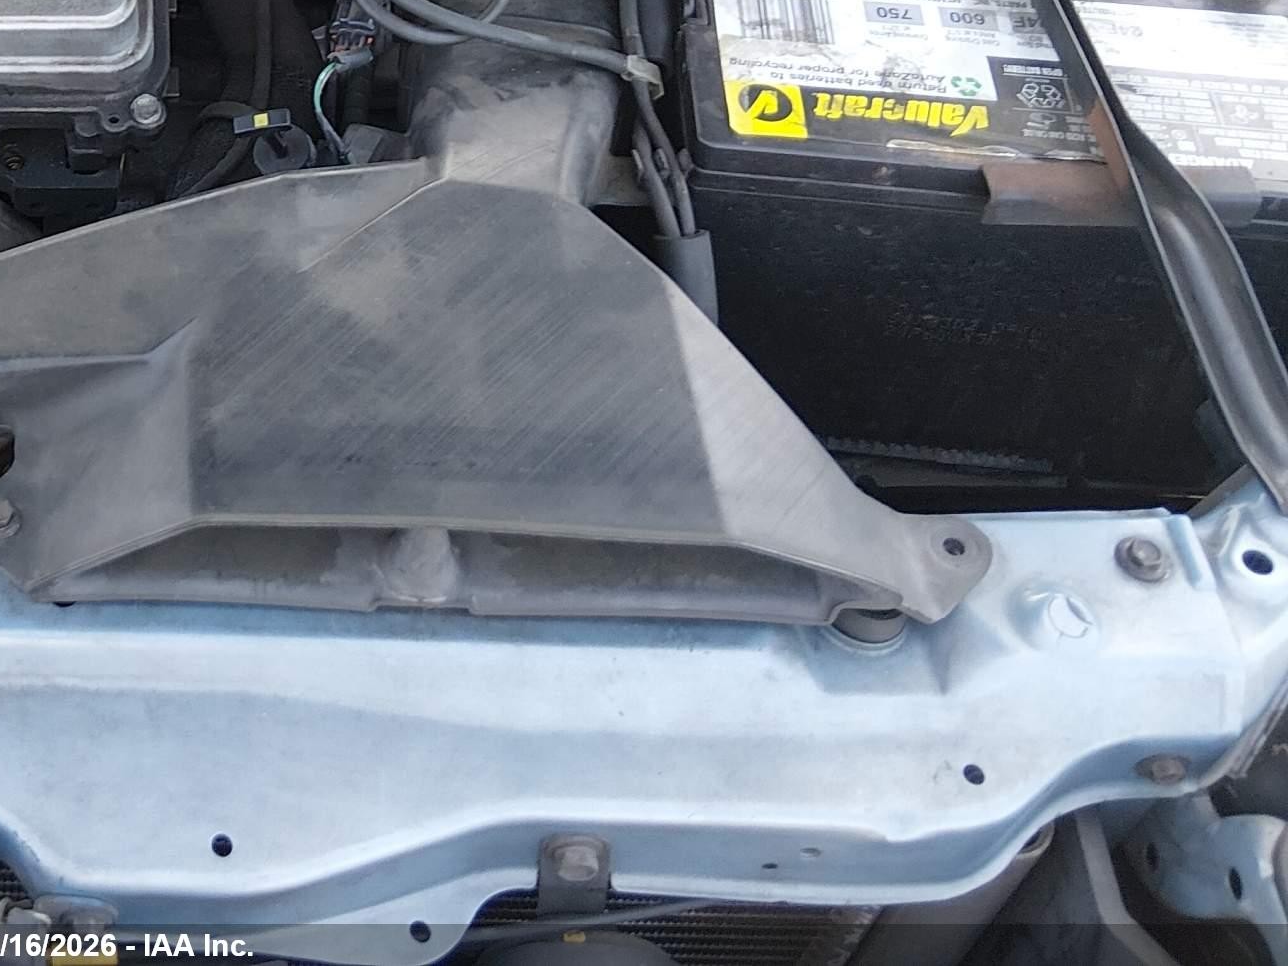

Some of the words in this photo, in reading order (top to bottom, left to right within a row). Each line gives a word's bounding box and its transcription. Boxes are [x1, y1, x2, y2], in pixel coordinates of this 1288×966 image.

[876, 7, 913, 20] 750
[950, 12, 985, 26] 600
[729, 57, 793, 70] recycling
[799, 64, 845, 75] proper
[770, 72, 785, 80] to
[849, 68, 870, 77] for
[874, 70, 946, 83] AutoZone
[789, 73, 853, 86] batteries
[897, 81, 947, 94] Return
[810, 92, 990, 138] Valucraft
